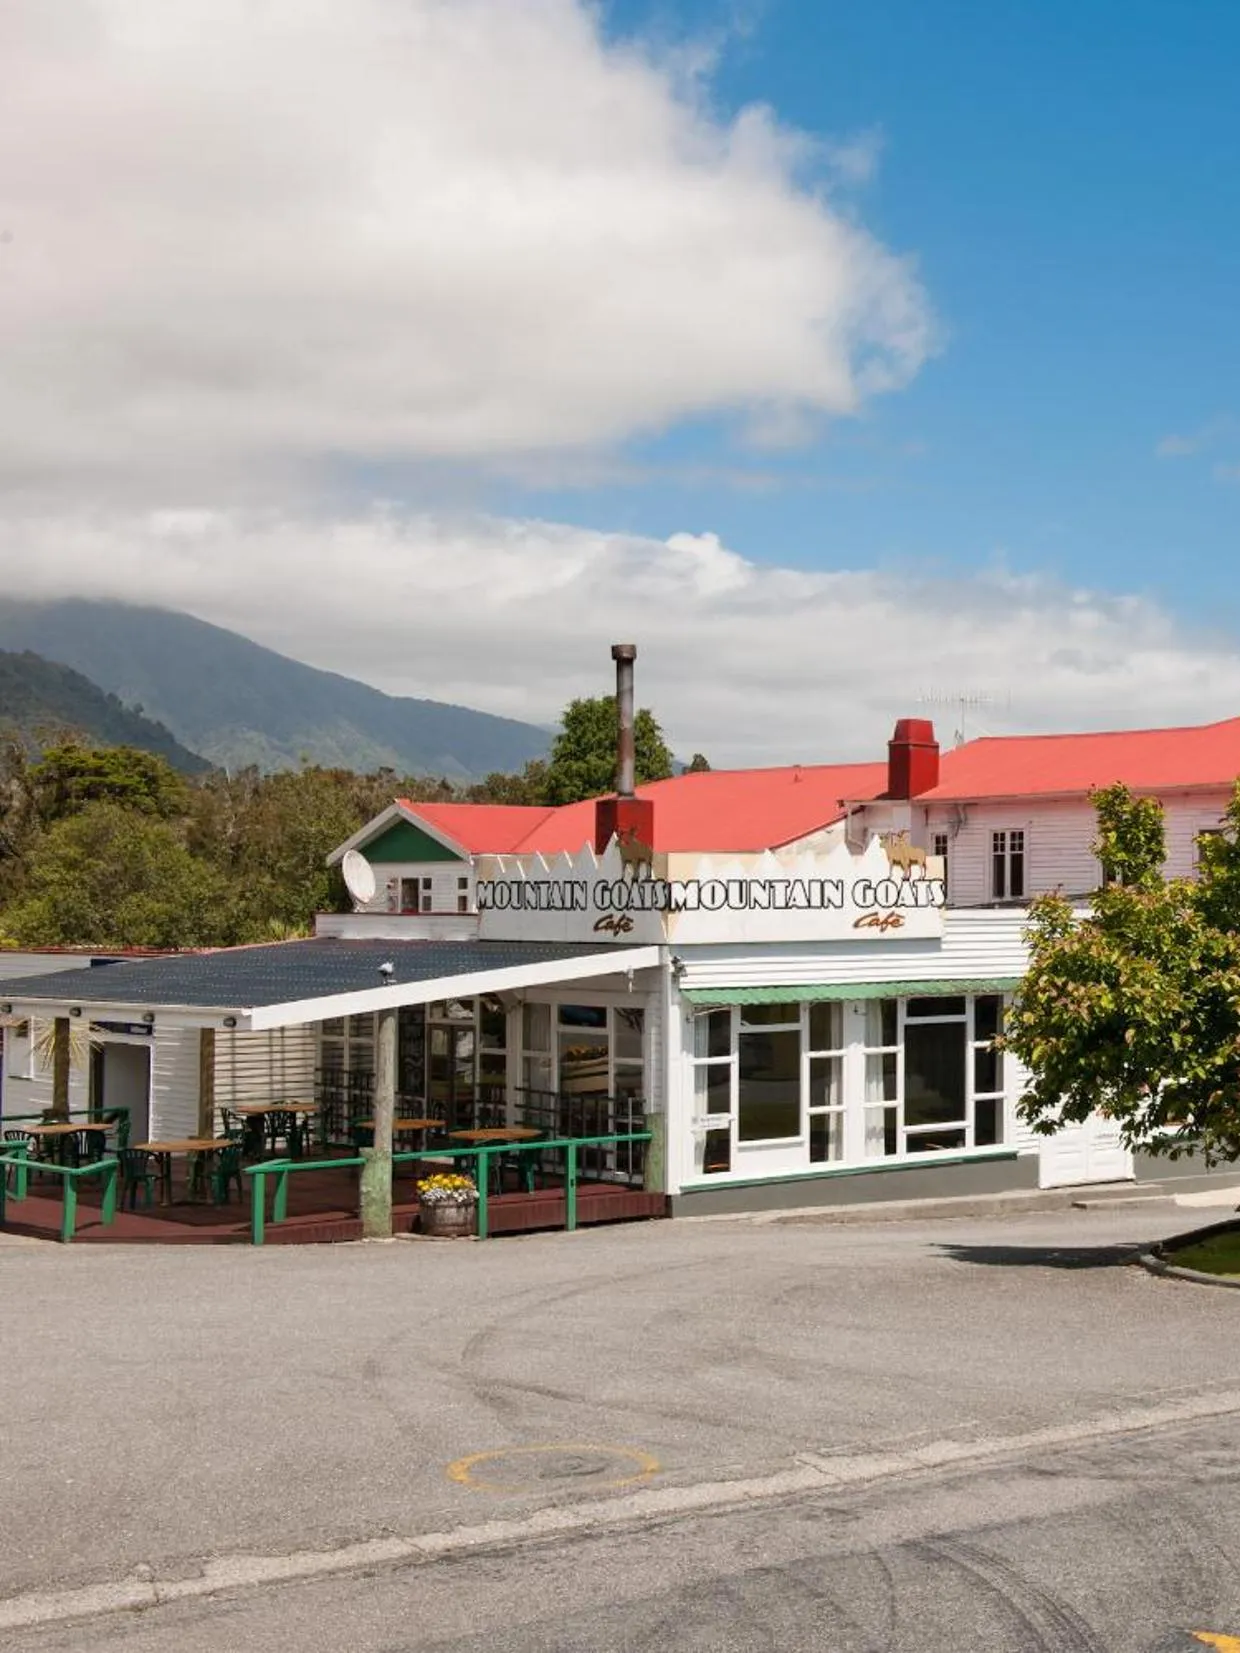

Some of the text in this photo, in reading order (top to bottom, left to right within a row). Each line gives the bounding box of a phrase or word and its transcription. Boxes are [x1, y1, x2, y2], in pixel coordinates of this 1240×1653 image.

[476, 879, 669, 911] MOUNTAIN GOATS
[670, 878, 946, 911] MOUNTAIN GOATS
